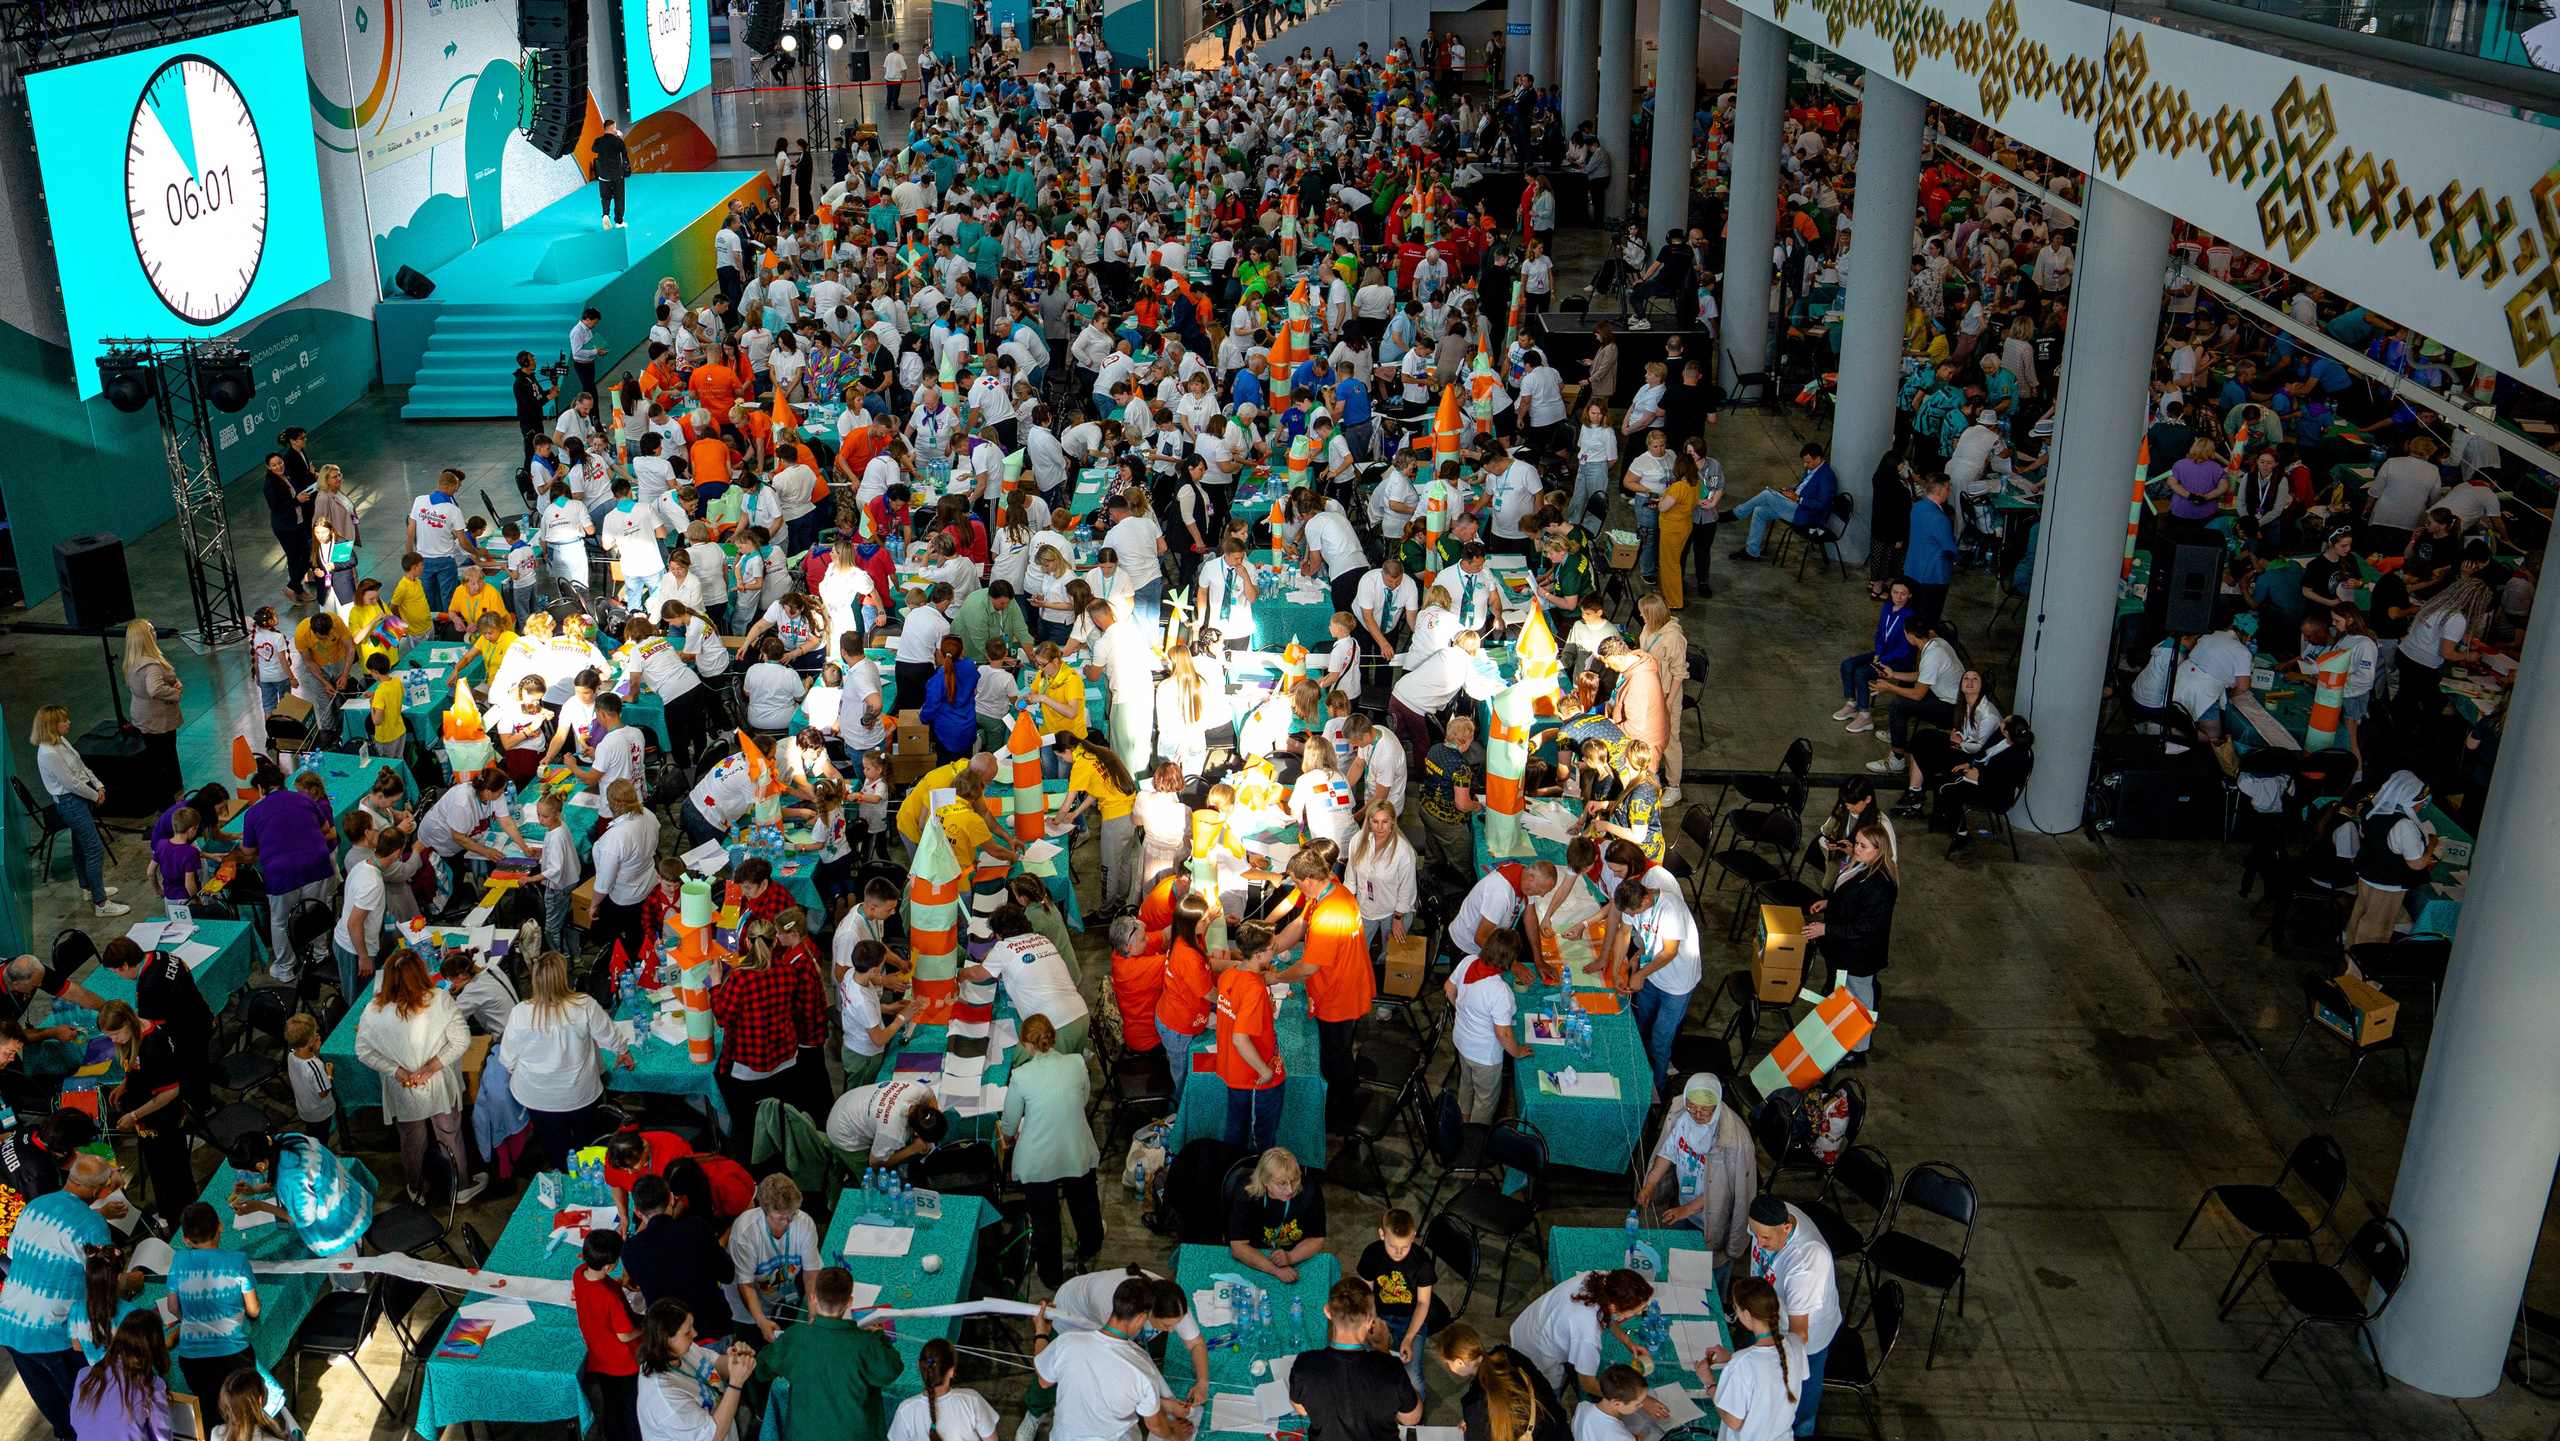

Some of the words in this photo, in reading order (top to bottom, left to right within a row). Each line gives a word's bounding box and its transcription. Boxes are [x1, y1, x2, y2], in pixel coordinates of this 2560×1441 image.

[659, 6, 680, 35] 06:01
[166, 164, 234, 226] 06:01
[2256, 675, 2270, 683] 119
[414, 689, 426, 699] 14
[2447, 847, 2467, 857] 120
[173, 910, 187, 920] 16
[878, 1082, 900, 1108] Марий
[883, 1083, 910, 1124] Республика
[541, 1182, 552, 1199] 52
[916, 1196, 935, 1209] 53
[1630, 1258, 1652, 1271] 89
